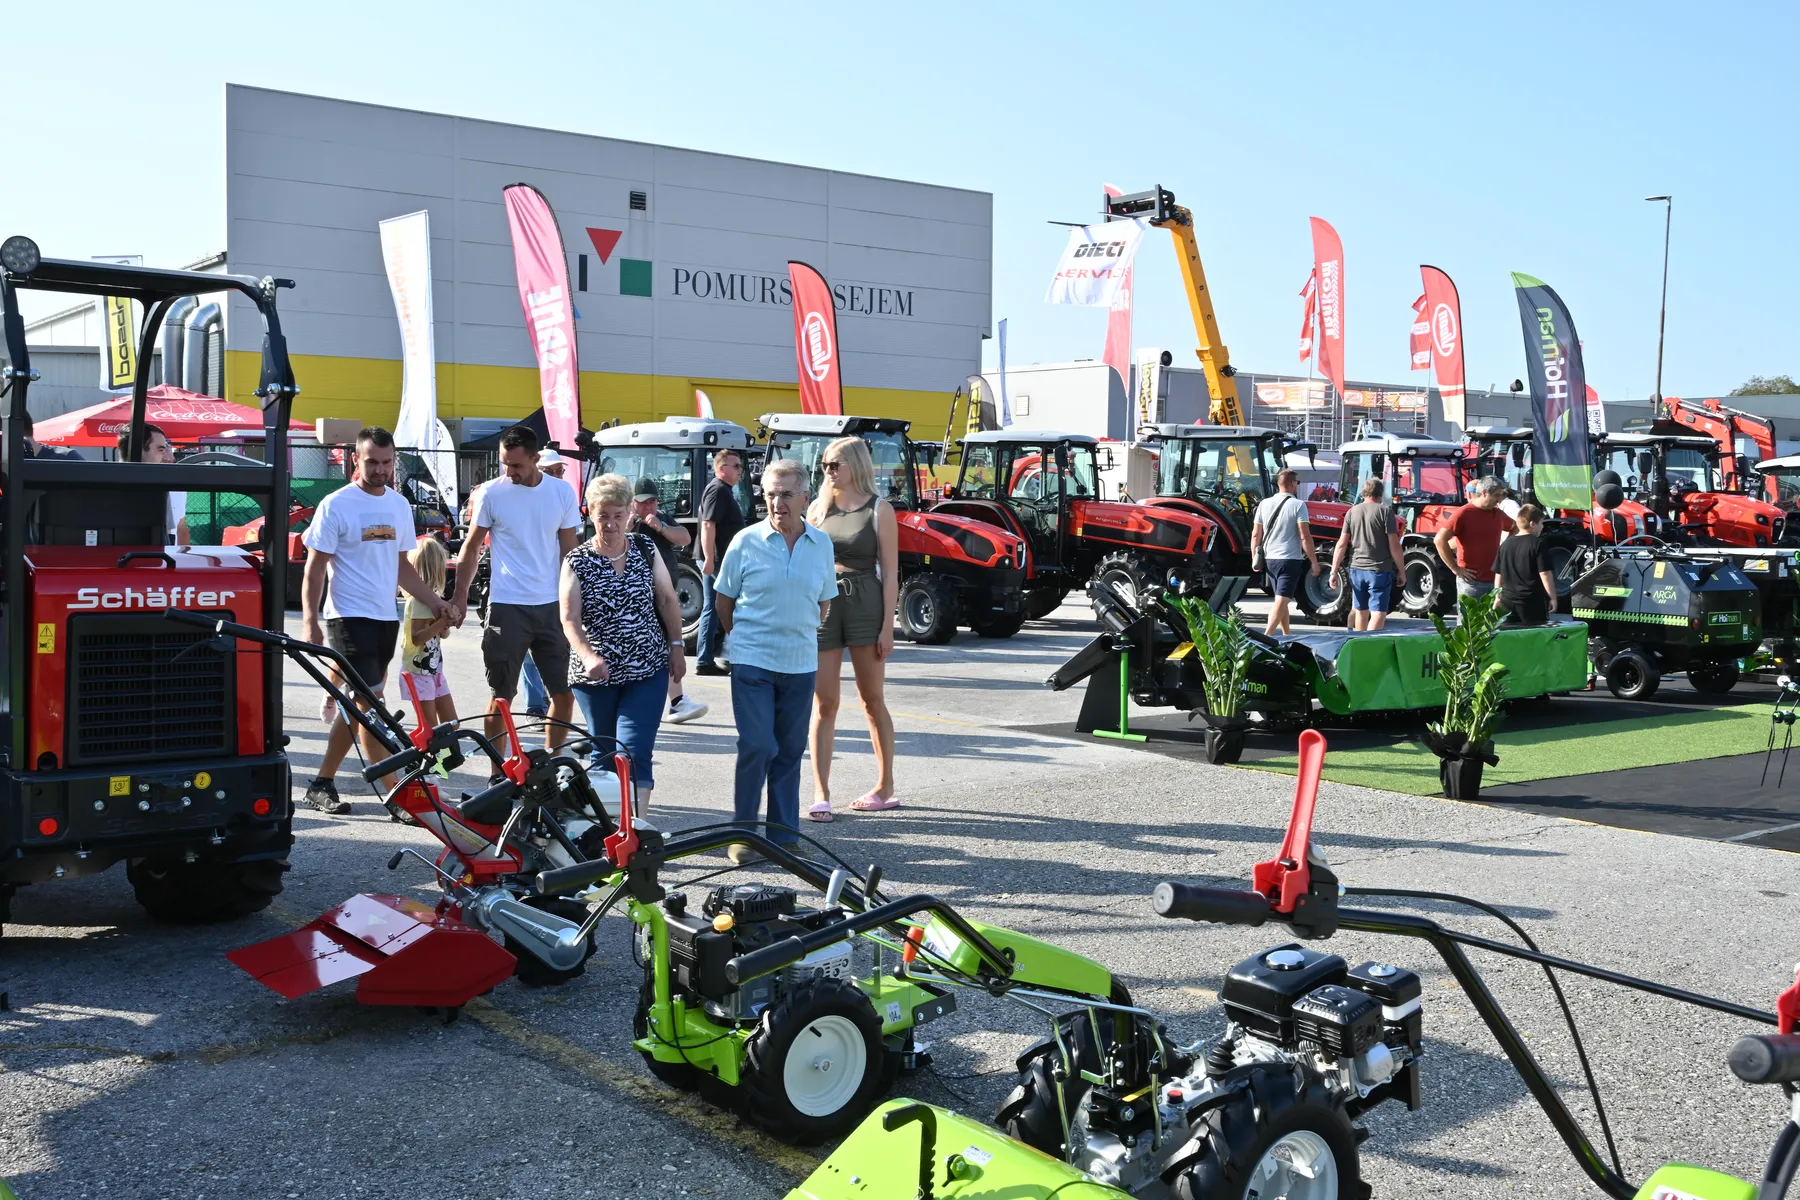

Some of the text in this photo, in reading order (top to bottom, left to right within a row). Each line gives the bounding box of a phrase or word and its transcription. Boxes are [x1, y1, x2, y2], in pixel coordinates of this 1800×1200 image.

[672, 268, 914, 316] POMURS SEJEM
[1225, 396, 1240, 426] DIE
[66, 586, 236, 609] Schäffer
[1653, 590, 1677, 600] ARGA
[1240, 678, 1267, 694] fman
